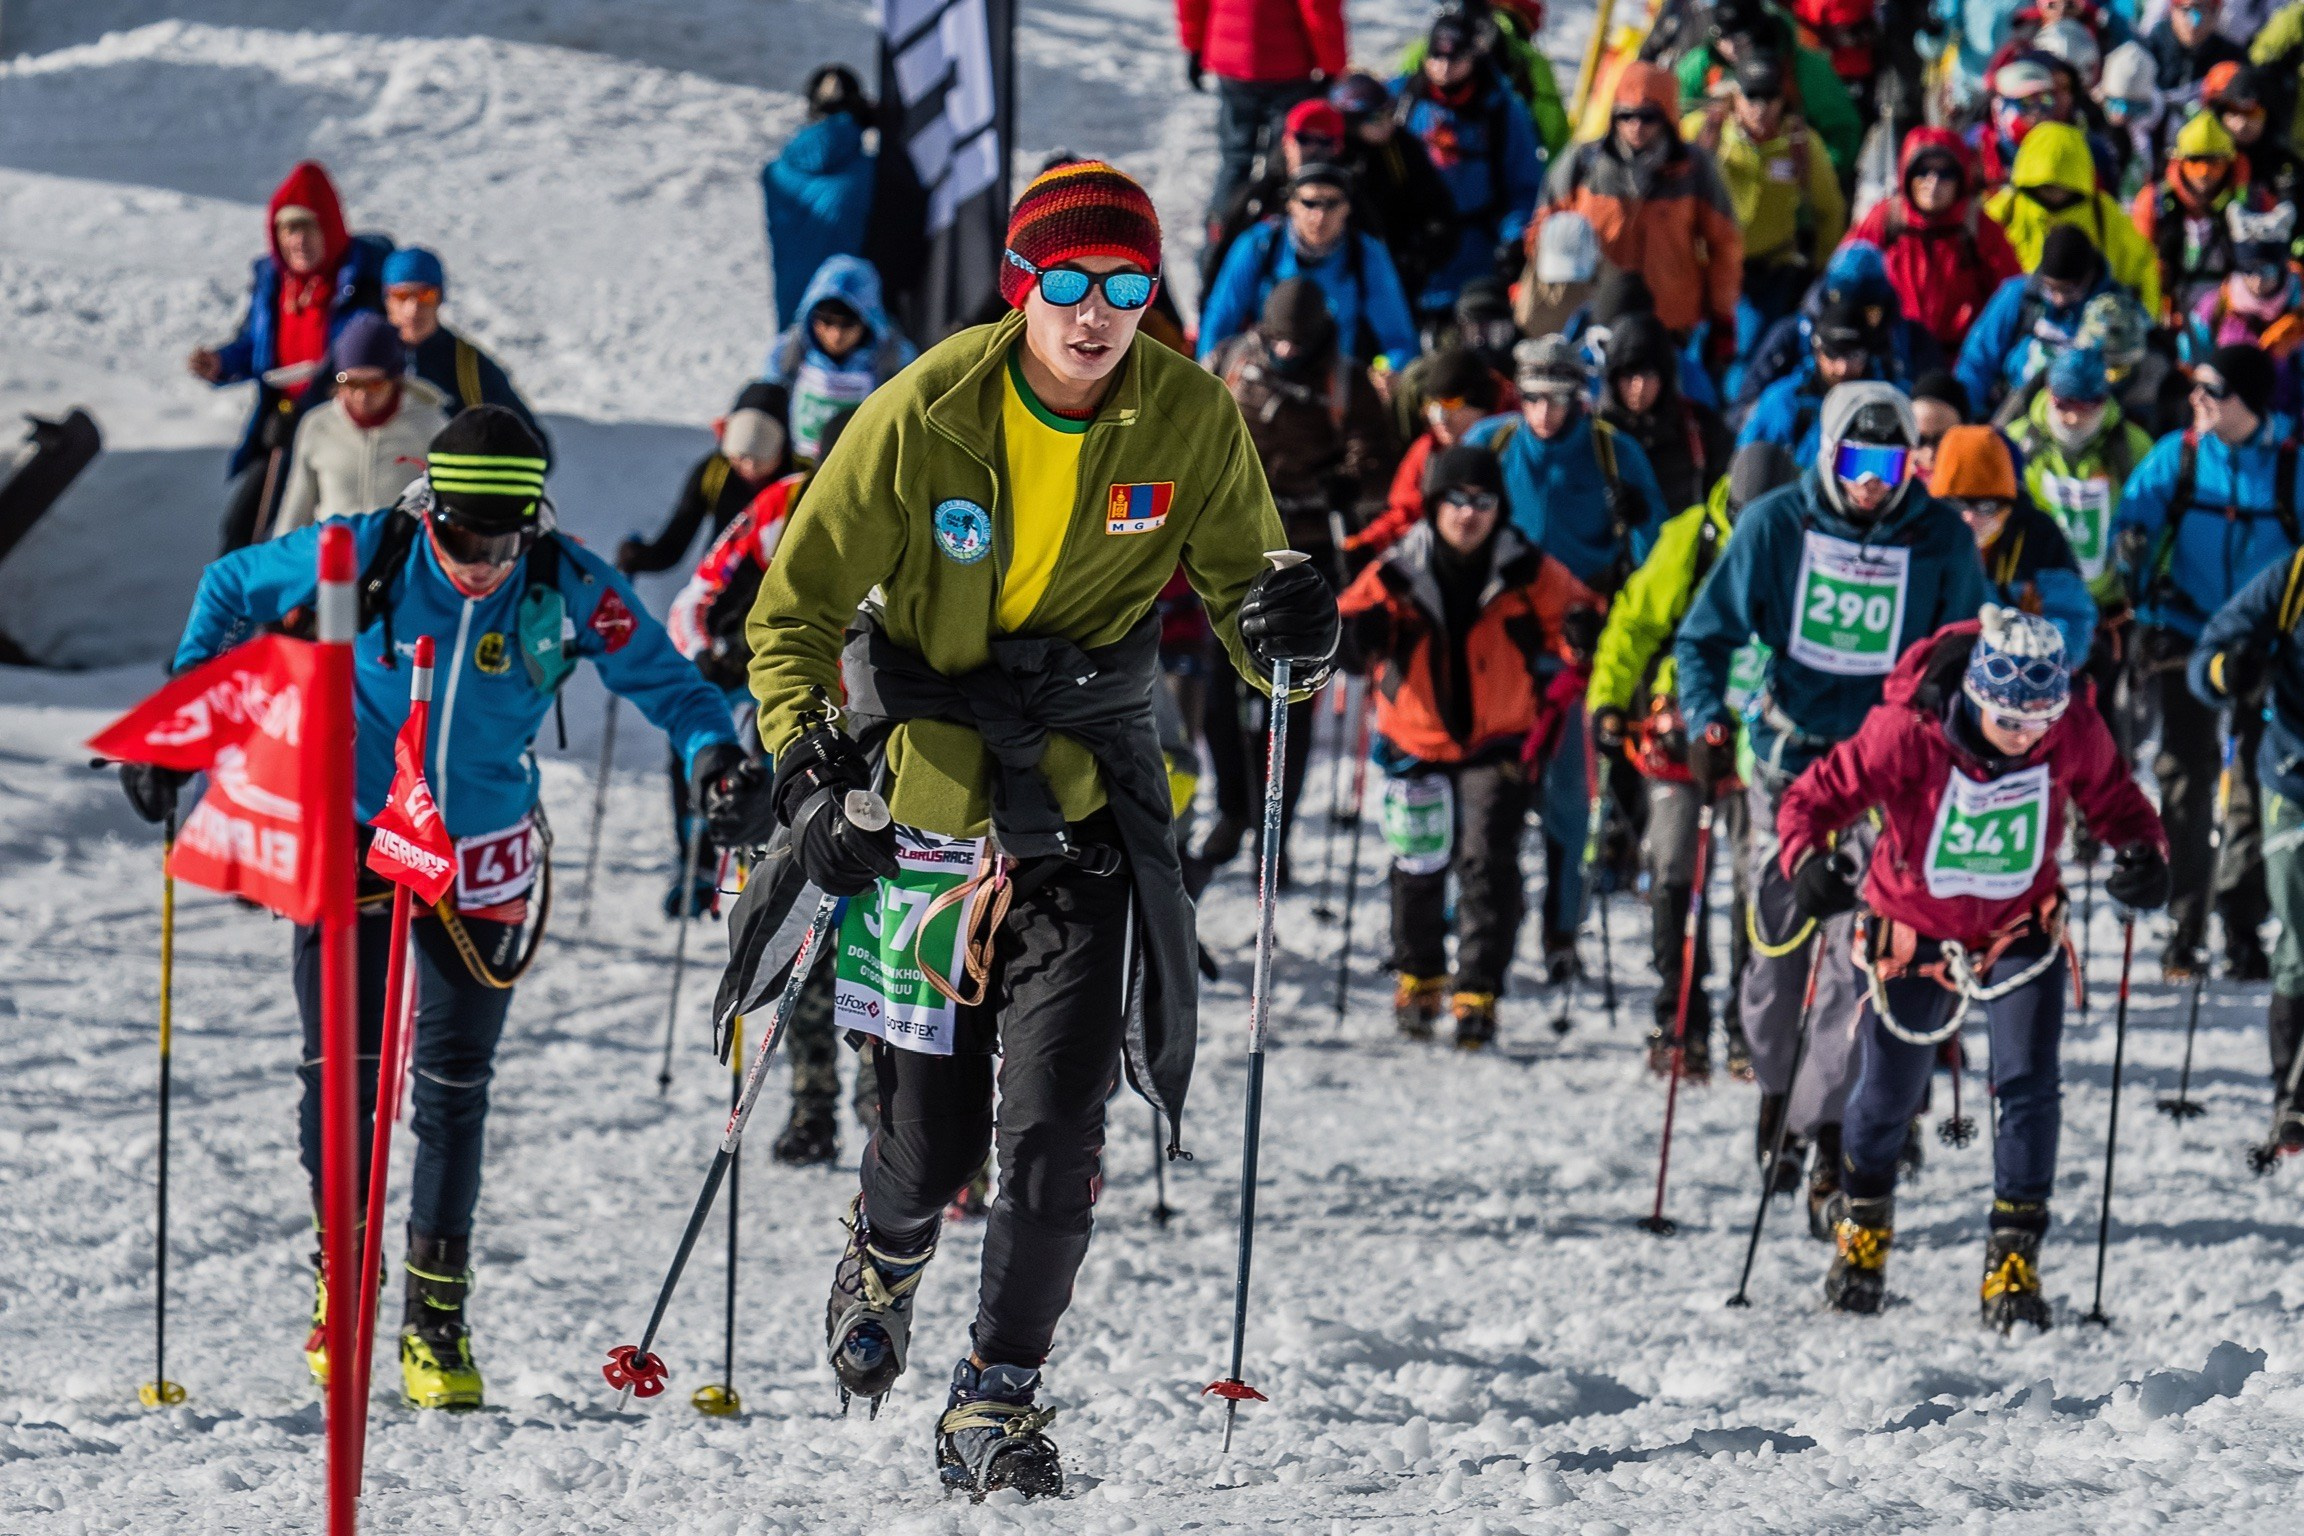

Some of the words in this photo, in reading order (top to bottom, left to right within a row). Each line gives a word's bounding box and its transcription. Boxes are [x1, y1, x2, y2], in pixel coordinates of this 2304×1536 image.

[1808, 584, 1891, 633] 290
[1945, 814, 2028, 855] 341
[864, 878, 931, 951] 37
